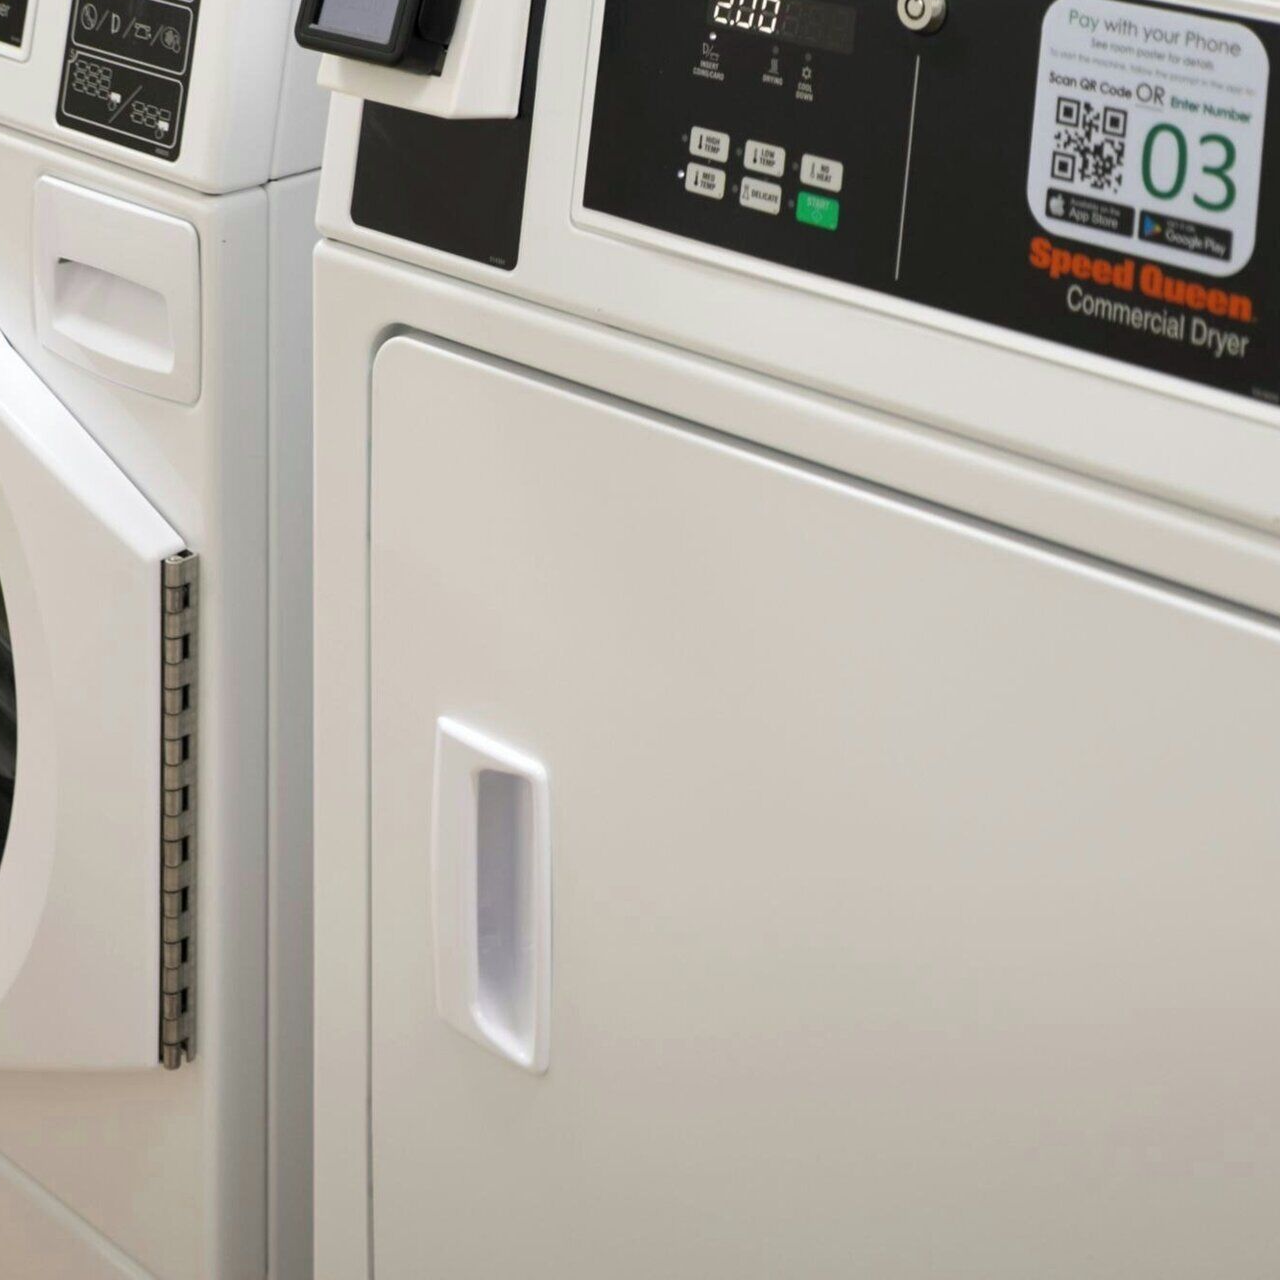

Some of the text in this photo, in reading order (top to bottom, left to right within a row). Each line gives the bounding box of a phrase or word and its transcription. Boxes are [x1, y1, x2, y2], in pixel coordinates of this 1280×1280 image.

[1068, 9, 1242, 57] Pay with your Phone
[1110, 43, 1135, 56] room
[1049, 71, 1253, 124] Scan QR Code OR Enter Number
[706, 135, 721, 146] HIGH
[704, 143, 721, 155] TEMP
[761, 149, 775, 159] LOW
[759, 156, 776, 167] TEMP
[1141, 122, 1238, 213] 03
[820, 164, 830, 173] NO
[702, 171, 716, 181] MED
[816, 171, 832, 183] HEAT
[700, 179, 716, 191] TEMP
[751, 189, 779, 203] DELICATE
[806, 196, 831, 208] START
[1070, 208, 1119, 229] App Store
[1165, 228, 1227, 257] Google Play
[1029, 236, 1253, 321] Speed Queen
[1066, 284, 1250, 359] Commercial Dryer
